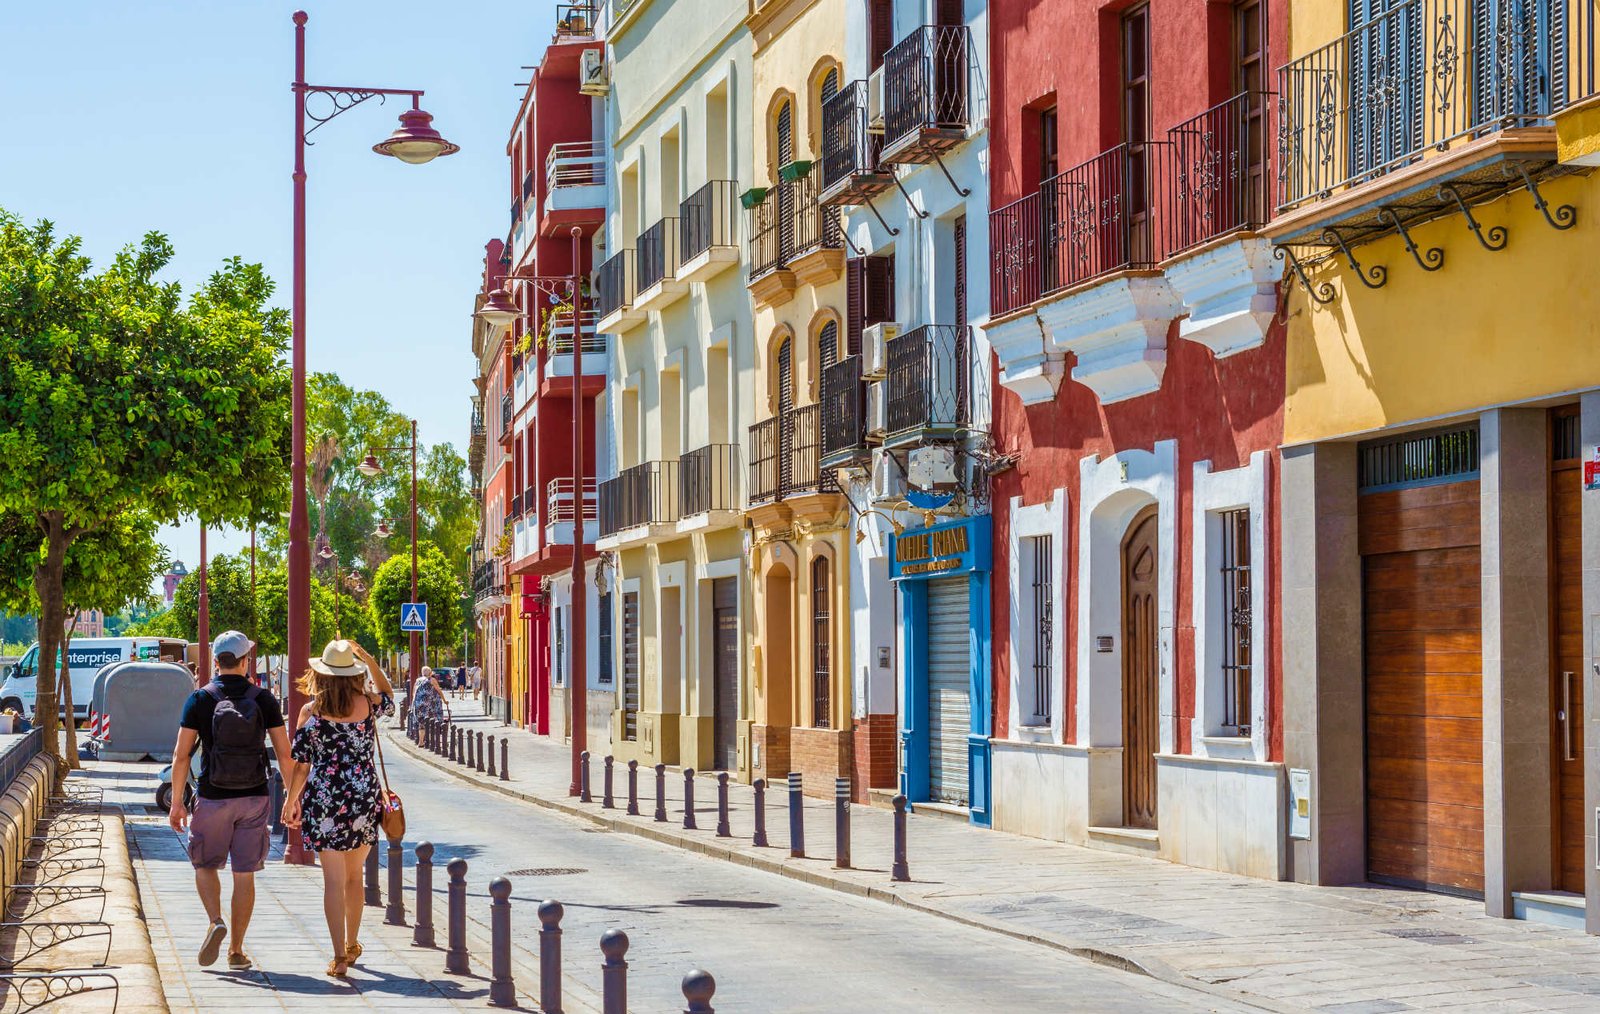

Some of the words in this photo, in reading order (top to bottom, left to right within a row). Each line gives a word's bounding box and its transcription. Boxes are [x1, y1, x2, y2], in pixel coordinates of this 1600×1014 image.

[896, 534, 930, 562] MUELLE
[930, 526, 968, 557] TRIANA
[56, 651, 120, 666] enterprise
